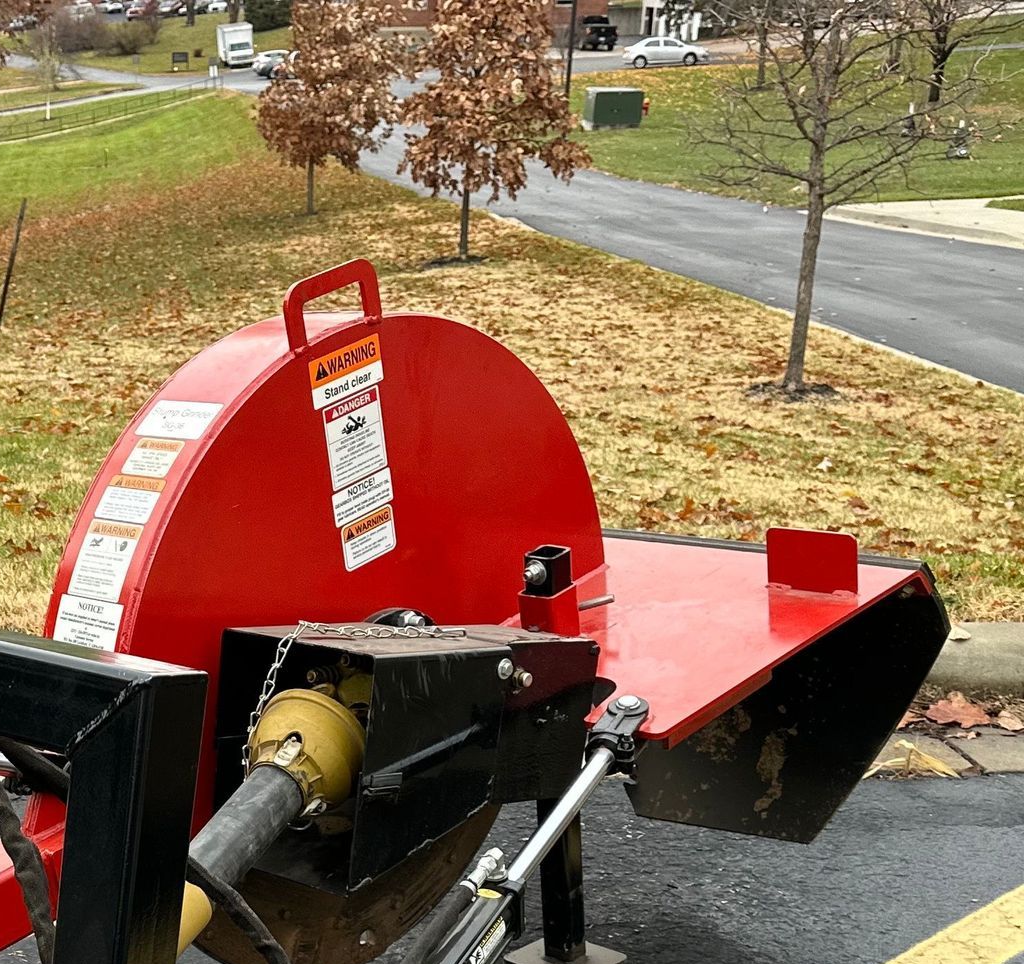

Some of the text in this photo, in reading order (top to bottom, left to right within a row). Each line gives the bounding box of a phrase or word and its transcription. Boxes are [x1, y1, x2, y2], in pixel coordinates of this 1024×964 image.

[327, 341, 377, 374] WARNING
[324, 371, 372, 400] Stand clear
[338, 393, 371, 416] DANGER
[125, 479, 159, 490] WARNING
[347, 477, 375, 497] NOTICE!
[100, 523, 137, 538] WARNING
[354, 511, 389, 534] WARNING
[78, 601, 104, 614] NOTICE!
